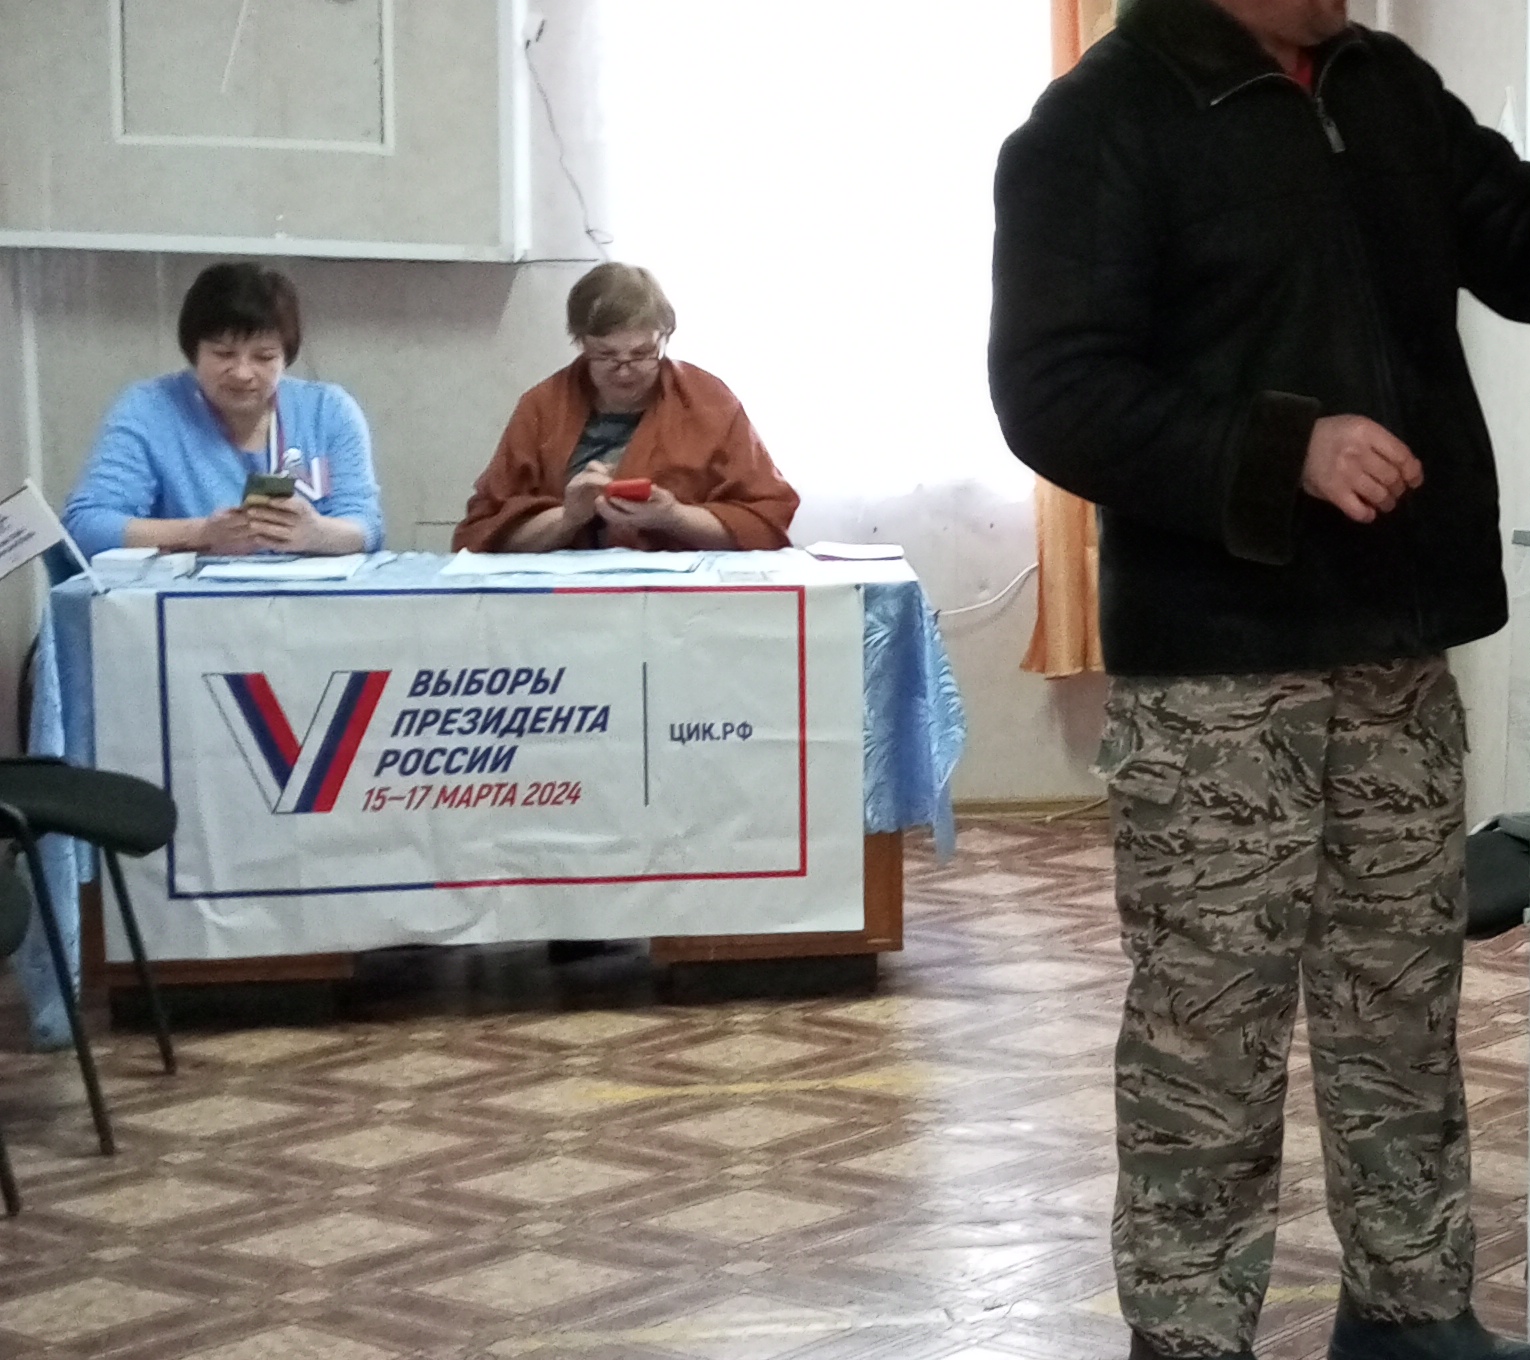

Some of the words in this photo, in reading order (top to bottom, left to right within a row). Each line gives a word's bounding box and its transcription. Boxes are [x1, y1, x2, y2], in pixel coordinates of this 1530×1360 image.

[408, 666, 566, 698] ВЫБОРЫ
[391, 704, 611, 738] ПРЕЗИДЕНТА
[669, 721, 753, 745] ЦИК.РФ
[374, 744, 519, 777] РОССИИ
[432, 782, 518, 809] МАРТА
[521, 780, 582, 807] 2024
